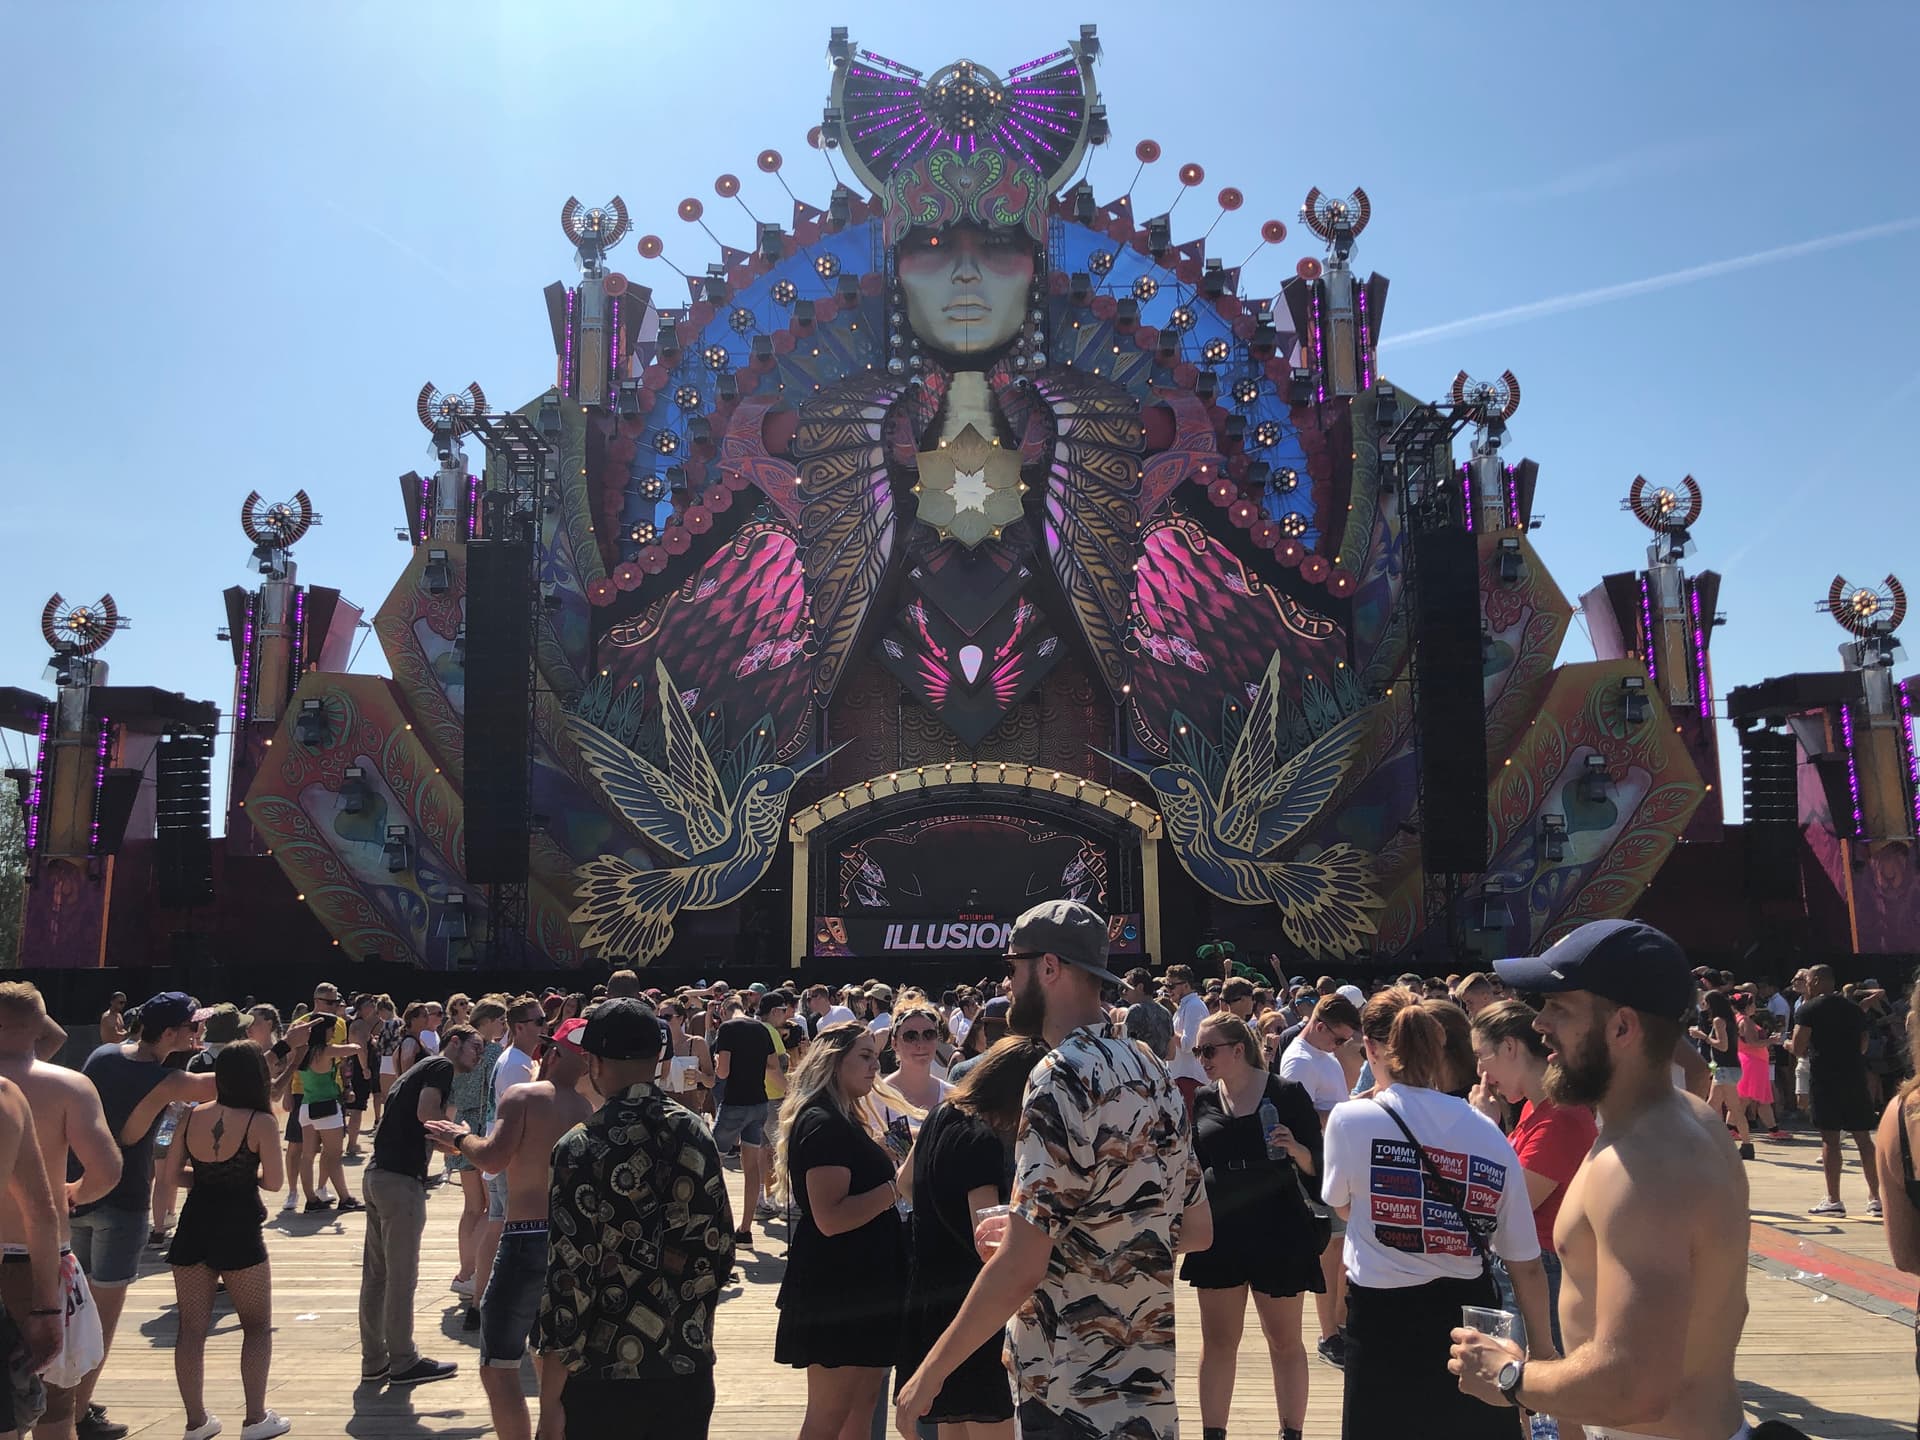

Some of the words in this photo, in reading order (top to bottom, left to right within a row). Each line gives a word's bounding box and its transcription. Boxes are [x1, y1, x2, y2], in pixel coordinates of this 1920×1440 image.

[1376, 1144, 1417, 1158] TOMMY
[1392, 1155, 1417, 1164] JEANS
[1426, 1151, 1464, 1168] TOMMY
[1473, 1161, 1505, 1179] TOMMY
[1375, 1200, 1417, 1214] TOMMY
[1391, 1210, 1417, 1221] JEANS
[1428, 1234, 1468, 1247] TOMMY
